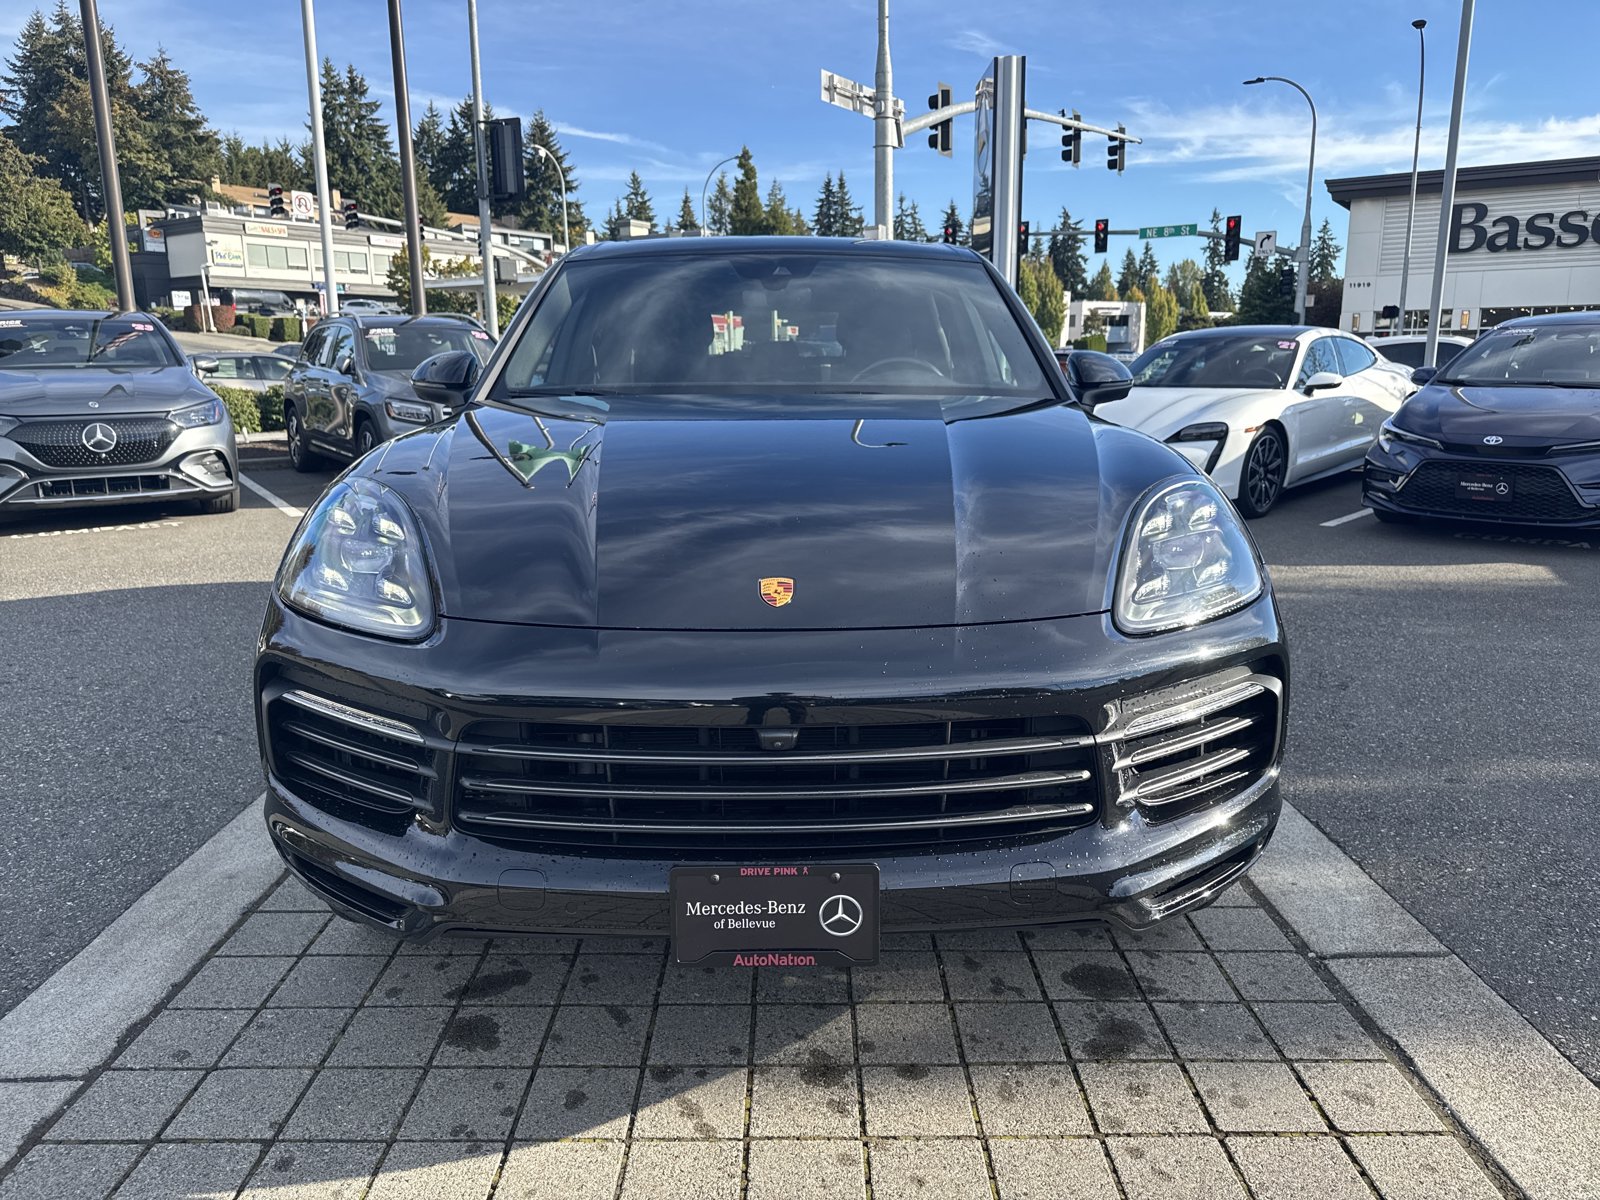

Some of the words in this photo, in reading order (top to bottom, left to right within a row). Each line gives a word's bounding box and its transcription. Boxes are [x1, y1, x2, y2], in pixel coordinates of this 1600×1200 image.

[1146, 227, 1158, 238] NE
[1163, 227, 1175, 237] 8th
[1180, 225, 1190, 236] St
[740, 867, 771, 876] DRIVE
[773, 867, 798, 876] PINK
[686, 900, 806, 916] Mercedes-Benz
[713, 918, 725, 930] of
[727, 918, 776, 930] Bellevue
[733, 953, 816, 967] AutoNation
